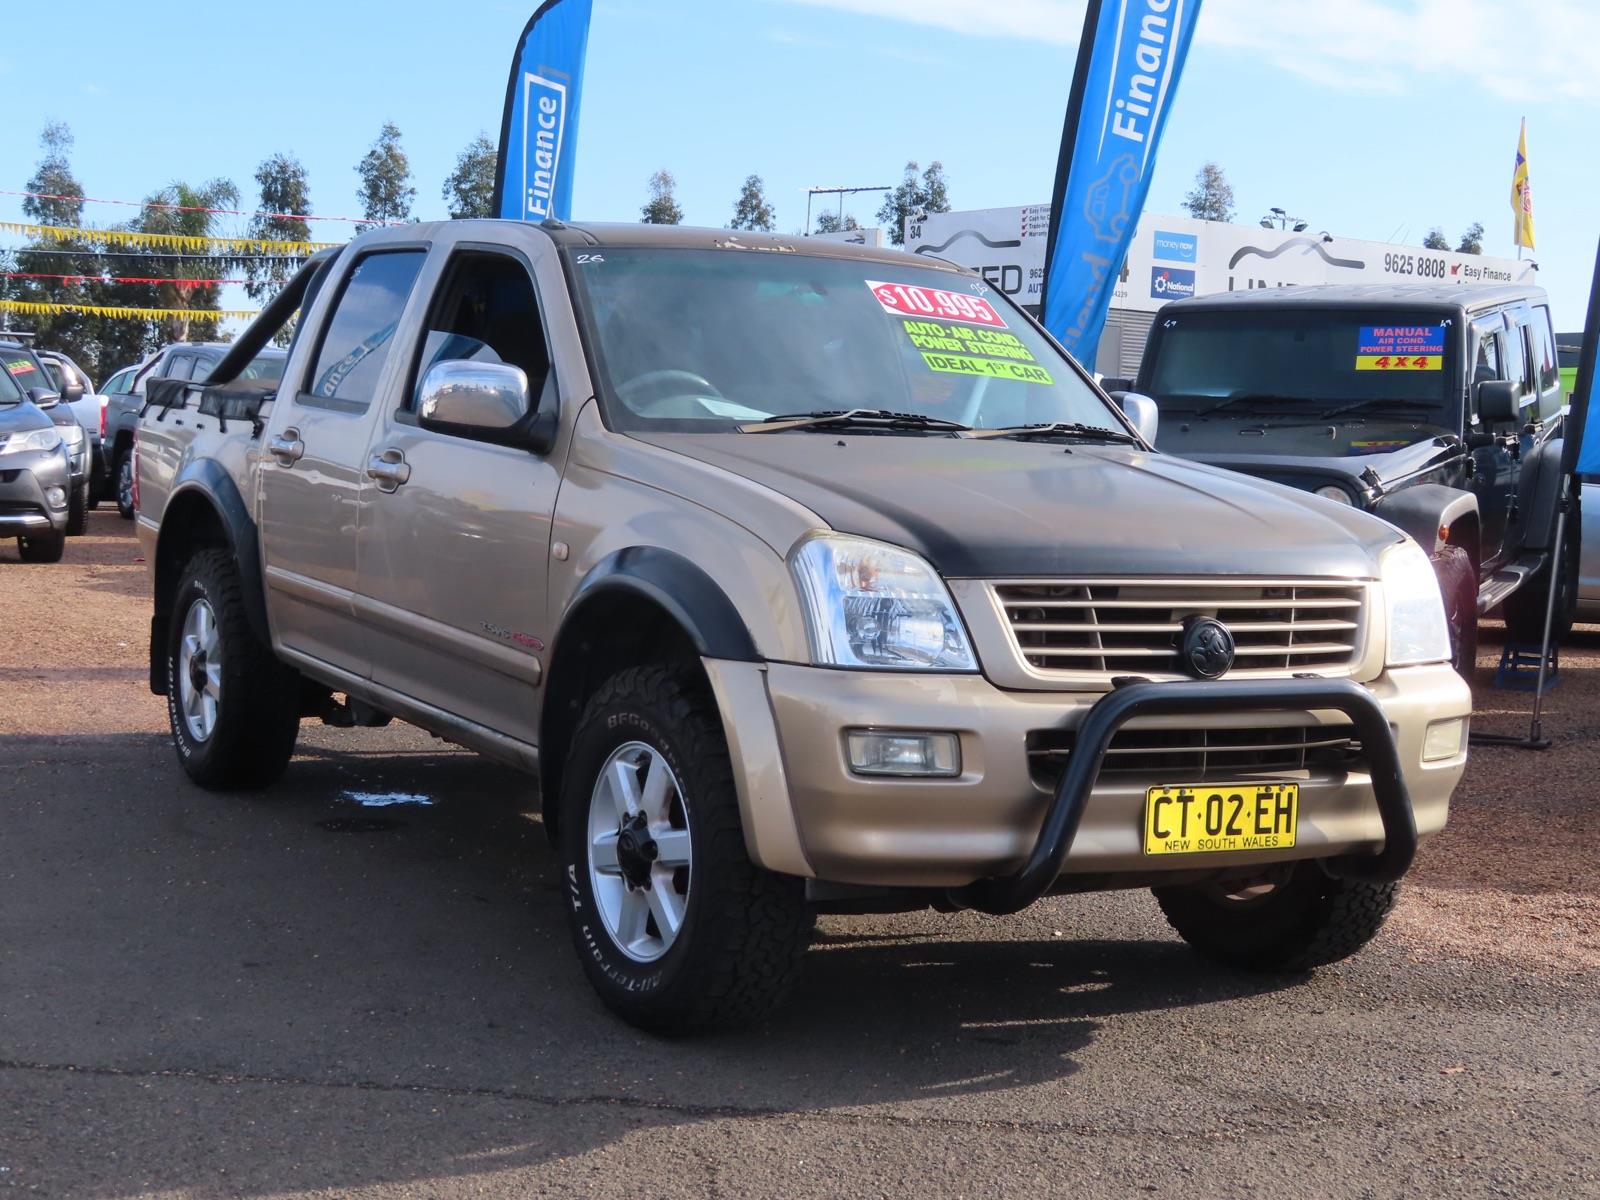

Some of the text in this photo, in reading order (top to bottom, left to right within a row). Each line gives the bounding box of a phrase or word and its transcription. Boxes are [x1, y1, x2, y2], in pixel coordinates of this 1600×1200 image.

[528, 96, 557, 215] Finance
[910, 225, 921, 239] 34
[577, 254, 605, 264] 26
[1384, 252, 1445, 279] 9625 8808
[1029, 267, 1045, 279] 962
[1464, 264, 1512, 282] Easy Finance
[1027, 282, 1045, 294] AUT
[1167, 280, 1193, 292] National
[879, 286, 993, 321] $10,995
[1373, 327, 1432, 337] MANUAL
[910, 334, 1035, 361] POWER STEERING
[927, 356, 985, 373] IDEAL
[1010, 365, 1050, 381] CAR
[1164, 836, 1279, 851] NEW SOUTH WALES
